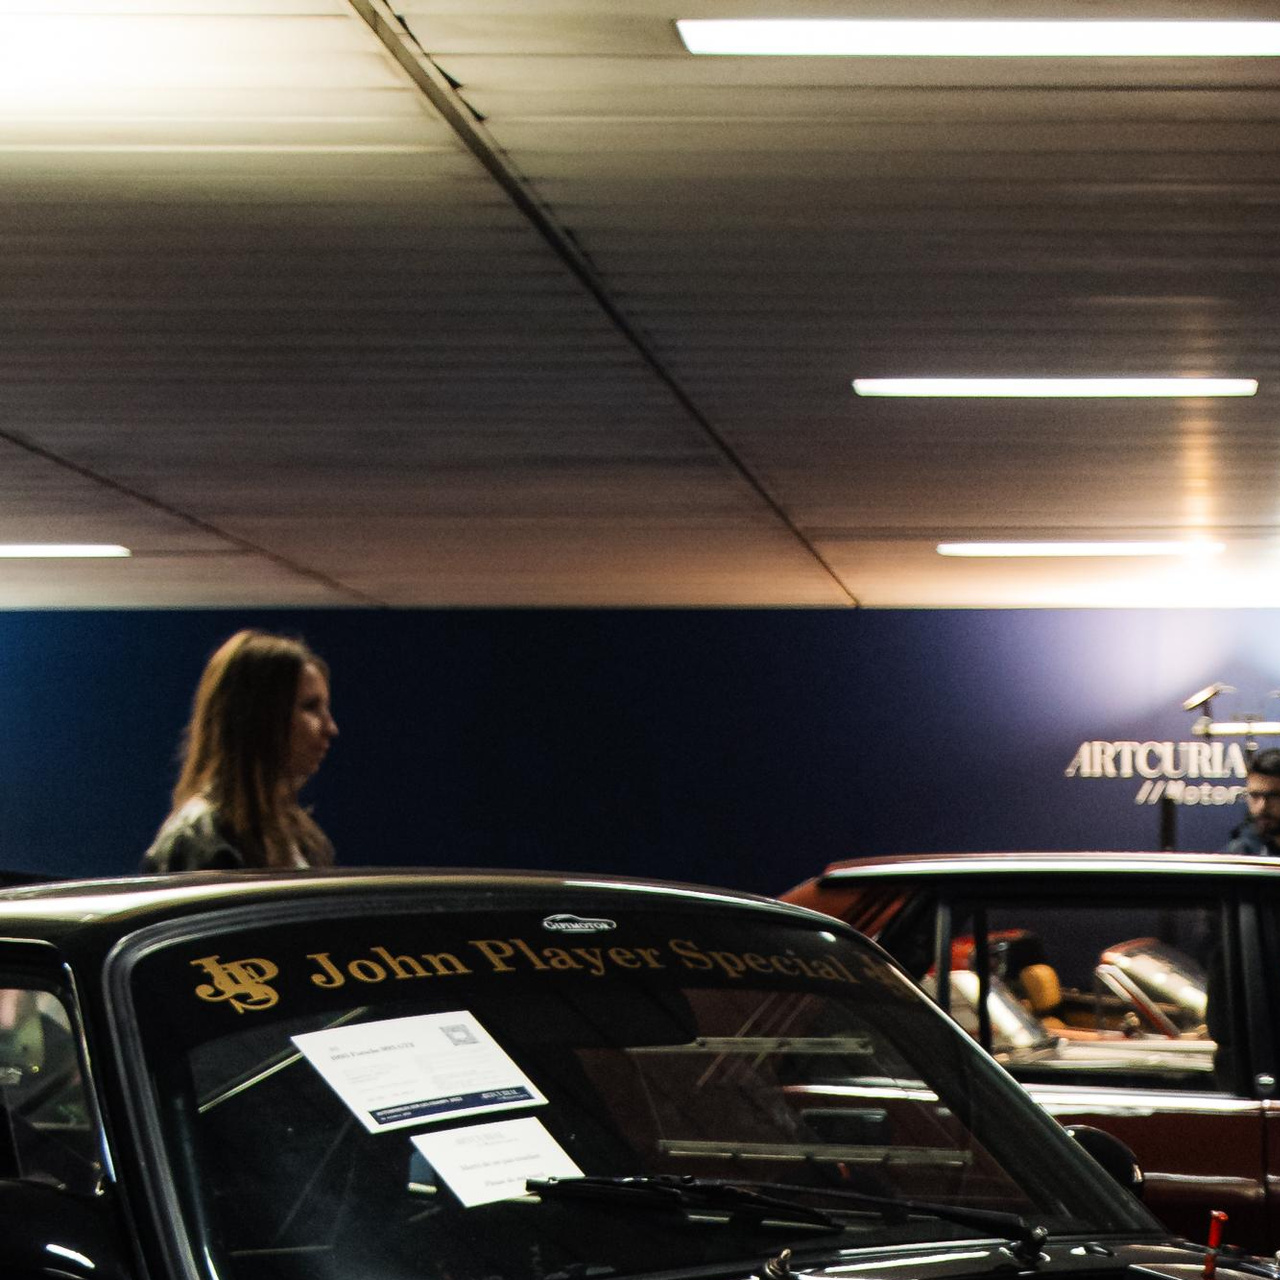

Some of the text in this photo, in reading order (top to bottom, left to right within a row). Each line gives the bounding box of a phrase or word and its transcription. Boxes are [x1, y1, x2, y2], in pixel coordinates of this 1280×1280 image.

[1065, 741, 1253, 779] ARTCURIA
[306, 946, 473, 989] John
[468, 938, 666, 976] Player
[668, 938, 860, 984] Special
